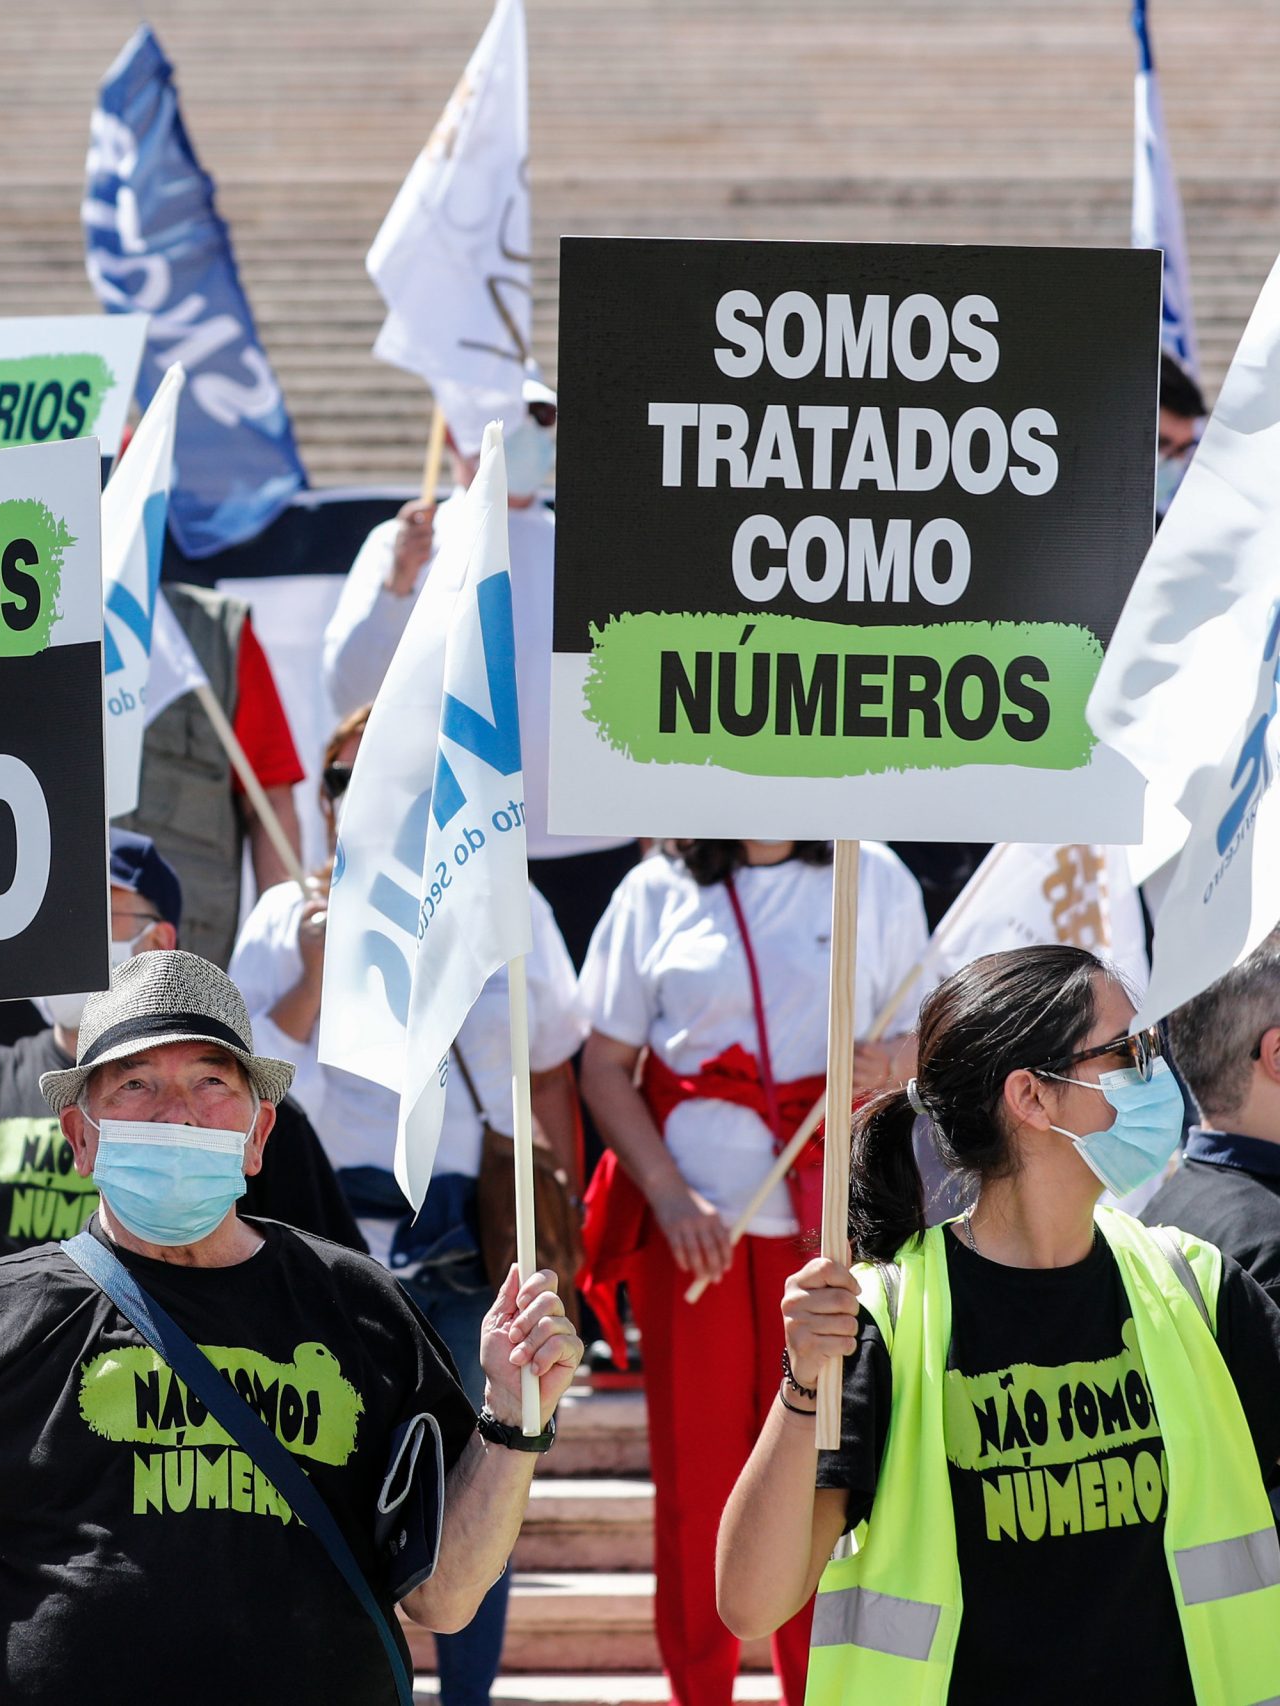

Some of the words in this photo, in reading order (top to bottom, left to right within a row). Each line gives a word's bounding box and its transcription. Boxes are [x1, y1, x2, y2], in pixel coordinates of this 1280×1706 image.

[714, 290, 1000, 384] SOMOS
[648, 402, 1060, 497] TRATADOS
[732, 514, 972, 606] COMO
[658, 625, 1050, 742] NÚMEROS
[972, 1372, 1049, 1458] NÃO
[1057, 1369, 1161, 1442] SOMO
